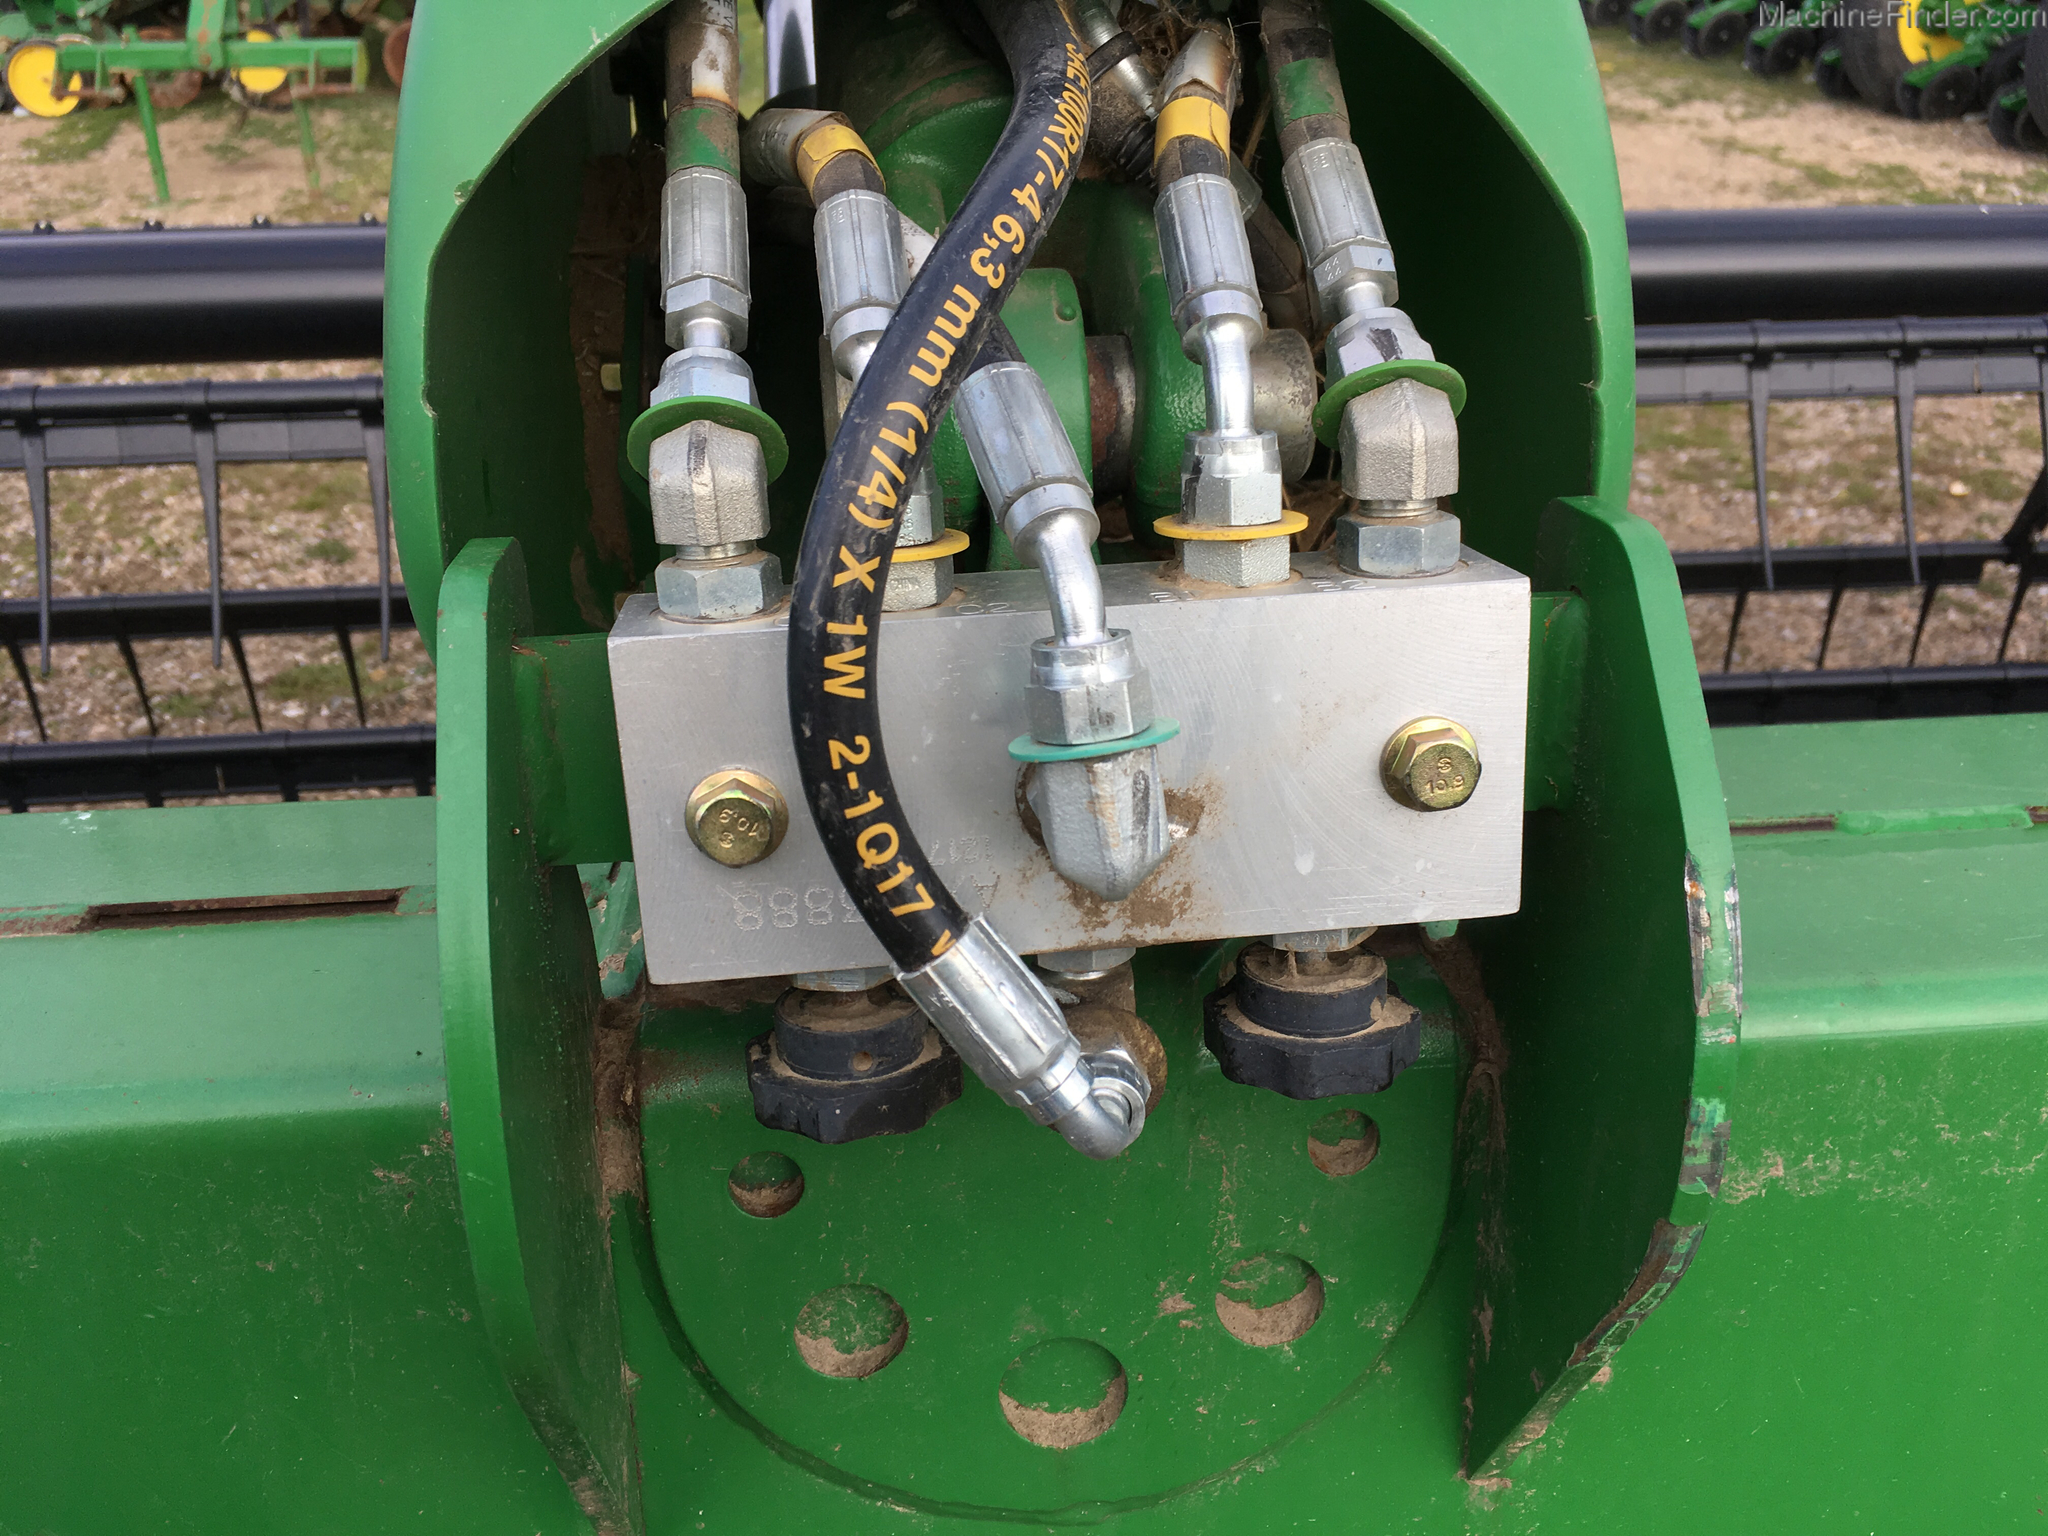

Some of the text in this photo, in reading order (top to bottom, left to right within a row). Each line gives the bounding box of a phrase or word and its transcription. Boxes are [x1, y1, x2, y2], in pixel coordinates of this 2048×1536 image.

[970, 214, 1026, 289] 6,3
[908, 284, 981, 387] mm
[848, 401, 929, 529] (1/4)
[832, 545, 881, 593] X
[823, 614, 868, 699] 1W
[828, 735, 936, 918] 2-1Q17
